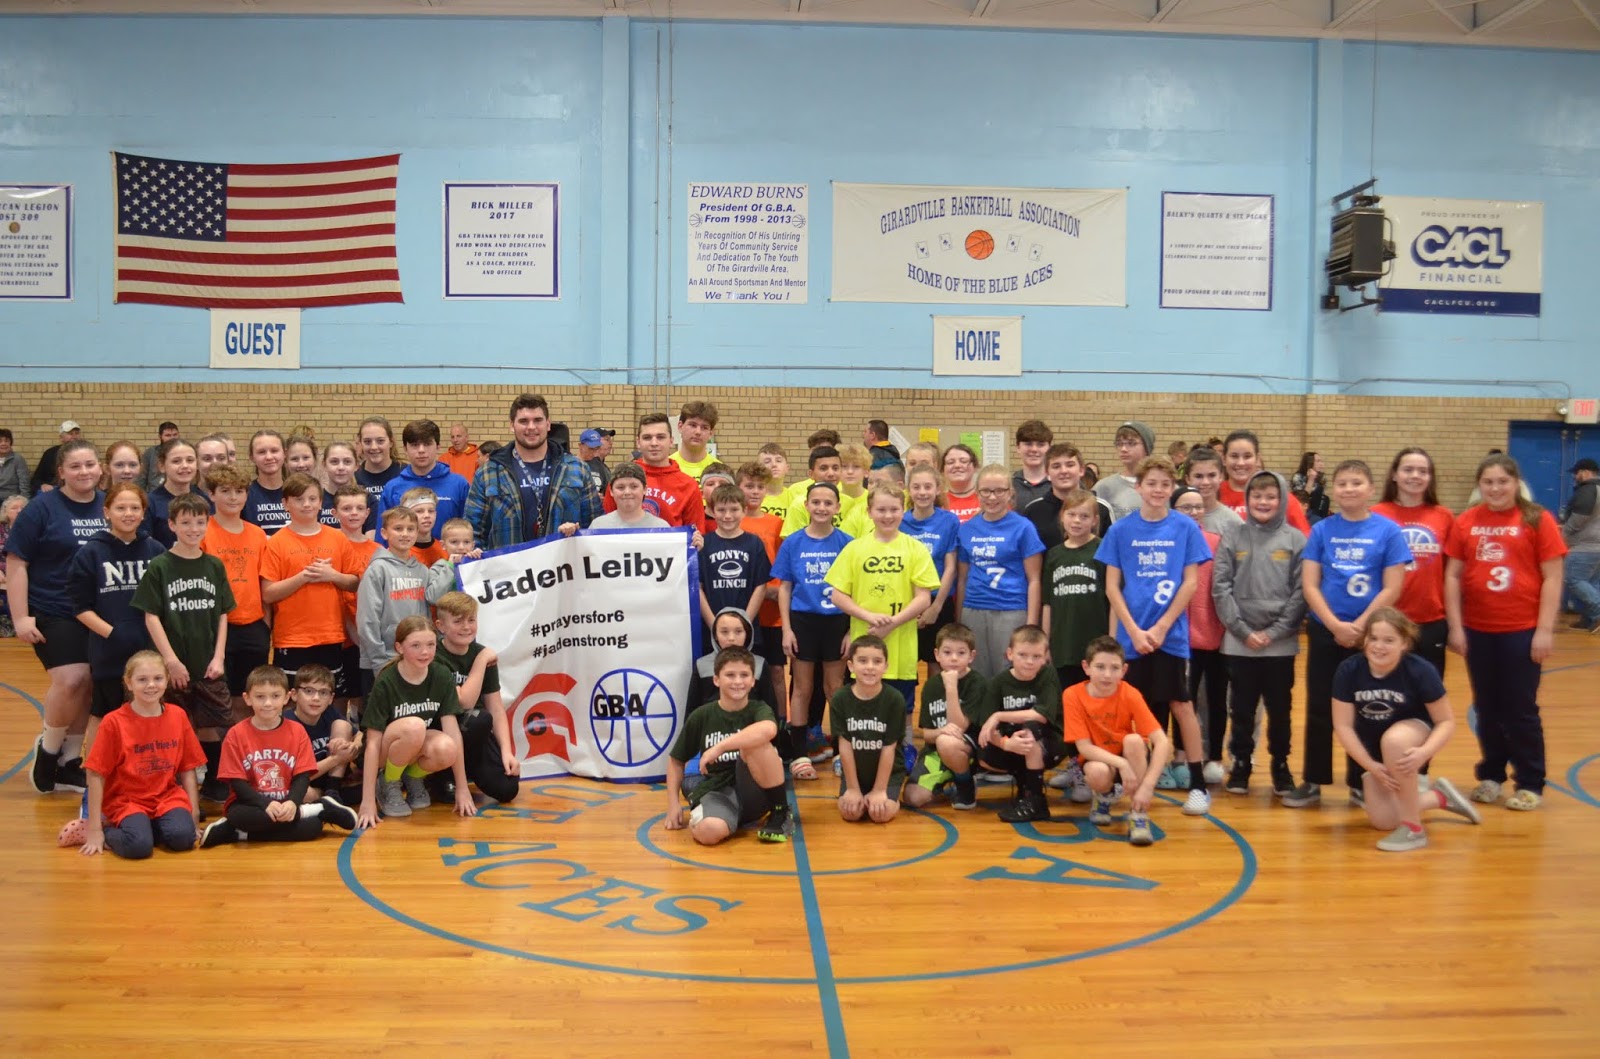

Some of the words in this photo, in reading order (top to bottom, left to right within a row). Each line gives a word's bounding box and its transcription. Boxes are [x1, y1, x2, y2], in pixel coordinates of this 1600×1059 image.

[691, 186, 753, 198] EDWARD
[756, 186, 804, 199] BURNS
[24, 203, 60, 211] LEGION
[471, 201, 494, 210] RICK
[498, 201, 534, 210] MILLER
[700, 204, 748, 212] President
[751, 204, 762, 212] Of
[766, 204, 796, 212] G.B.A.
[21, 213, 40, 221] 309
[489, 212, 516, 220] 2017
[704, 214, 730, 222] From
[734, 215, 758, 223] 1998
[767, 216, 792, 224] 2013
[880, 198, 946, 234] GIRARDVILLE
[950, 196, 1012, 218] BASKETBALL
[1018, 200, 1081, 238] ASSOCIATION
[694, 231, 702, 240] In
[704, 231, 746, 241] Recognition
[748, 232, 757, 240] Of
[758, 232, 770, 240] His
[772, 232, 800, 242] Untiring
[698, 242, 717, 250] Years
[720, 242, 728, 250] Of
[730, 242, 770, 252] Community
[772, 242, 798, 251] Service
[1410, 224, 1510, 270] CACL
[696, 253, 710, 262] And
[712, 253, 750, 262] Dedication
[753, 253, 762, 262] To
[764, 254, 776, 262] The
[779, 254, 798, 262] Youth
[706, 264, 715, 272] Of
[717, 264, 730, 272] The
[732, 264, 768, 272] Girardville
[770, 264, 789, 273] Area.
[734, 278, 768, 287] Sportsman
[770, 278, 782, 286] And
[784, 279, 806, 287] Mentor
[908, 263, 942, 290] HOME
[944, 276, 960, 294] OF
[963, 278, 986, 294] THE
[988, 276, 1018, 294] BLUE
[1023, 264, 1053, 288] ACES
[1420, 272, 1502, 284] FINANCIAL
[705, 292, 722, 300] We
[763, 292, 782, 300] You
[225, 322, 286, 356] GUEST
[955, 330, 1000, 361] HOME
[1574, 400, 1596, 416] EXIT
[646, 488, 676, 506] RTAN
[257, 503, 284, 512] MICHAE
[258, 512, 290, 521] O'CONNO
[74, 528, 110, 536] O'CON
[1470, 526, 1518, 536] BALKY'S
[710, 550, 749, 563] TONY'S
[863, 556, 904, 574] CACL
[478, 562, 574, 604] Jaden
[583, 552, 674, 582] Leiby
[986, 567, 1006, 589] 7
[1053, 564, 1096, 582] Hibernian
[1486, 566, 1510, 592] 3
[168, 576, 216, 598] Hibernian
[713, 579, 746, 588] LUNCH
[1058, 583, 1088, 596] House
[1346, 573, 1370, 597] 6
[821, 587, 836, 608] 3
[1154, 580, 1175, 604] 8
[530, 610, 624, 637] #prayersfor6
[532, 634, 628, 658] #jadenstrong
[1354, 689, 1406, 702] TONY'S
[594, 694, 646, 718] GBA
[243, 748, 296, 770] SPARTAN
[438, 837, 743, 935] ACES
